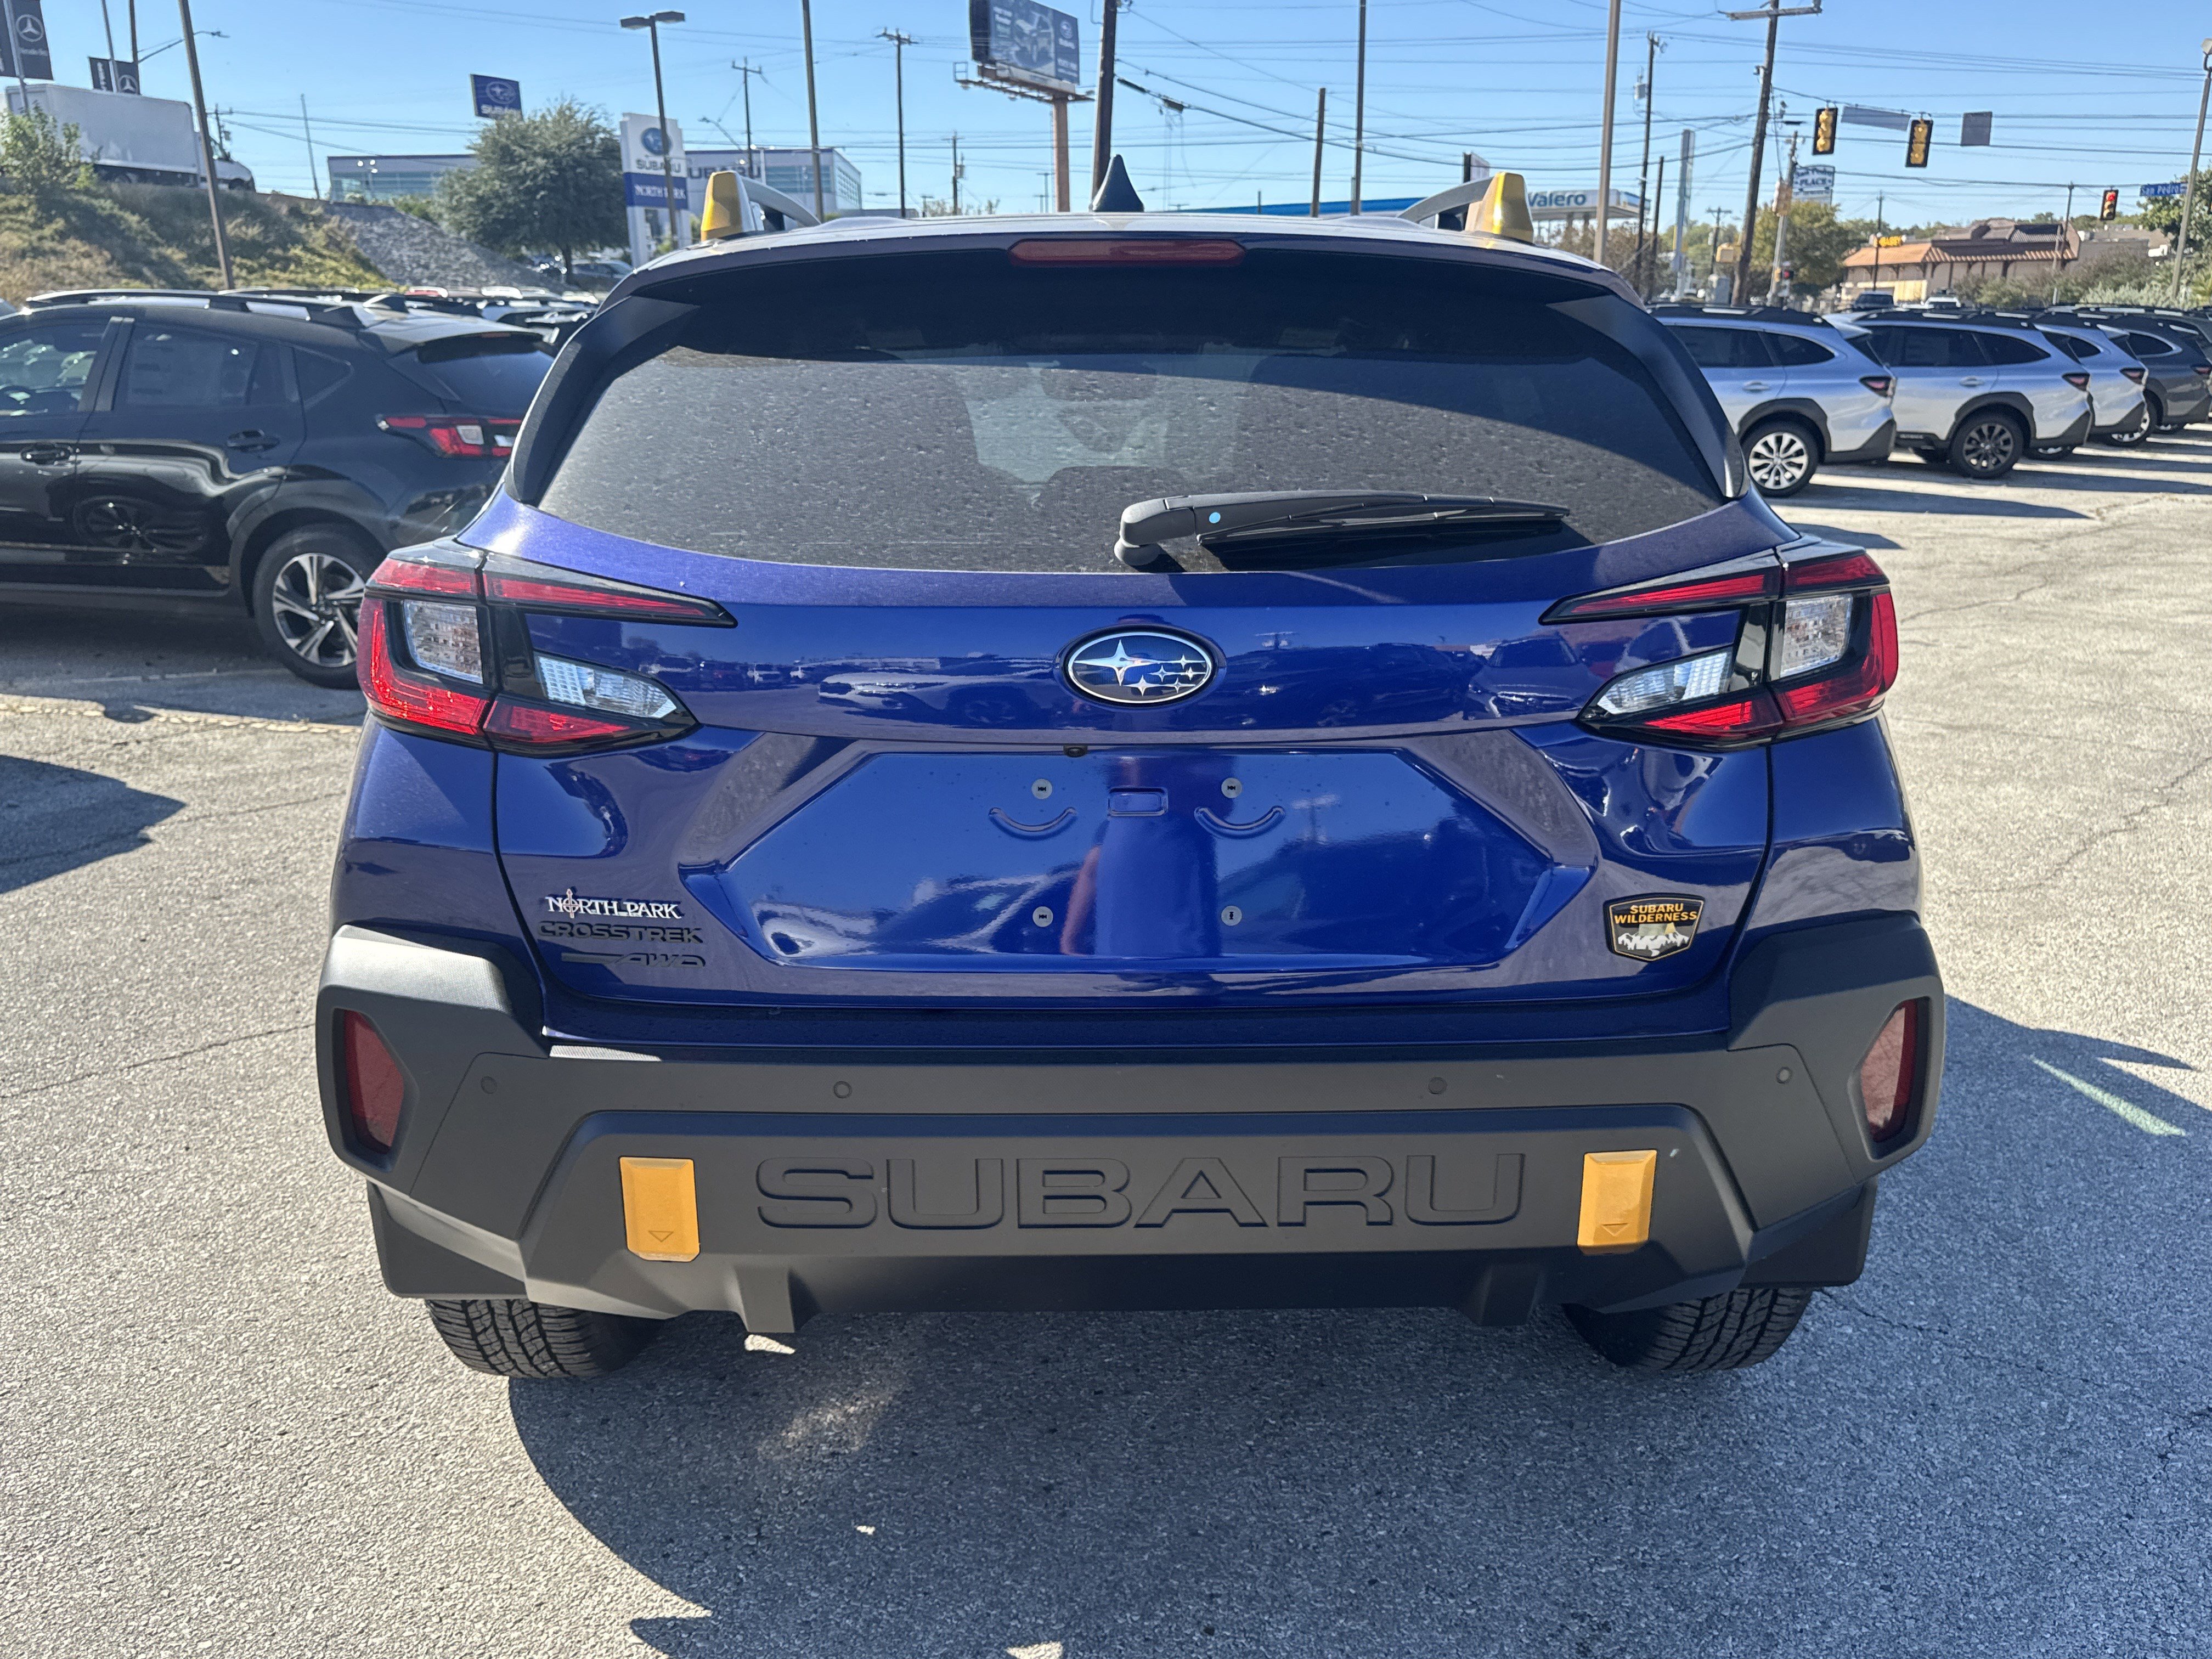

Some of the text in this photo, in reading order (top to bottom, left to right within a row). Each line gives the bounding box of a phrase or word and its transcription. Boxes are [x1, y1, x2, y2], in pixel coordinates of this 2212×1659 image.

[2142, 187, 2155, 195] San
[2157, 184, 2180, 194] Pedro
[1528, 193, 1587, 207] Valero
[545, 889, 682, 919] NORTH PARK
[1629, 903, 1684, 915] SUBARU
[1614, 911, 1698, 924] WILDERNESS
[537, 921, 703, 944] CROSSTREK
[612, 952, 706, 968] AWD
[756, 1153, 1526, 1231] SUBARU
